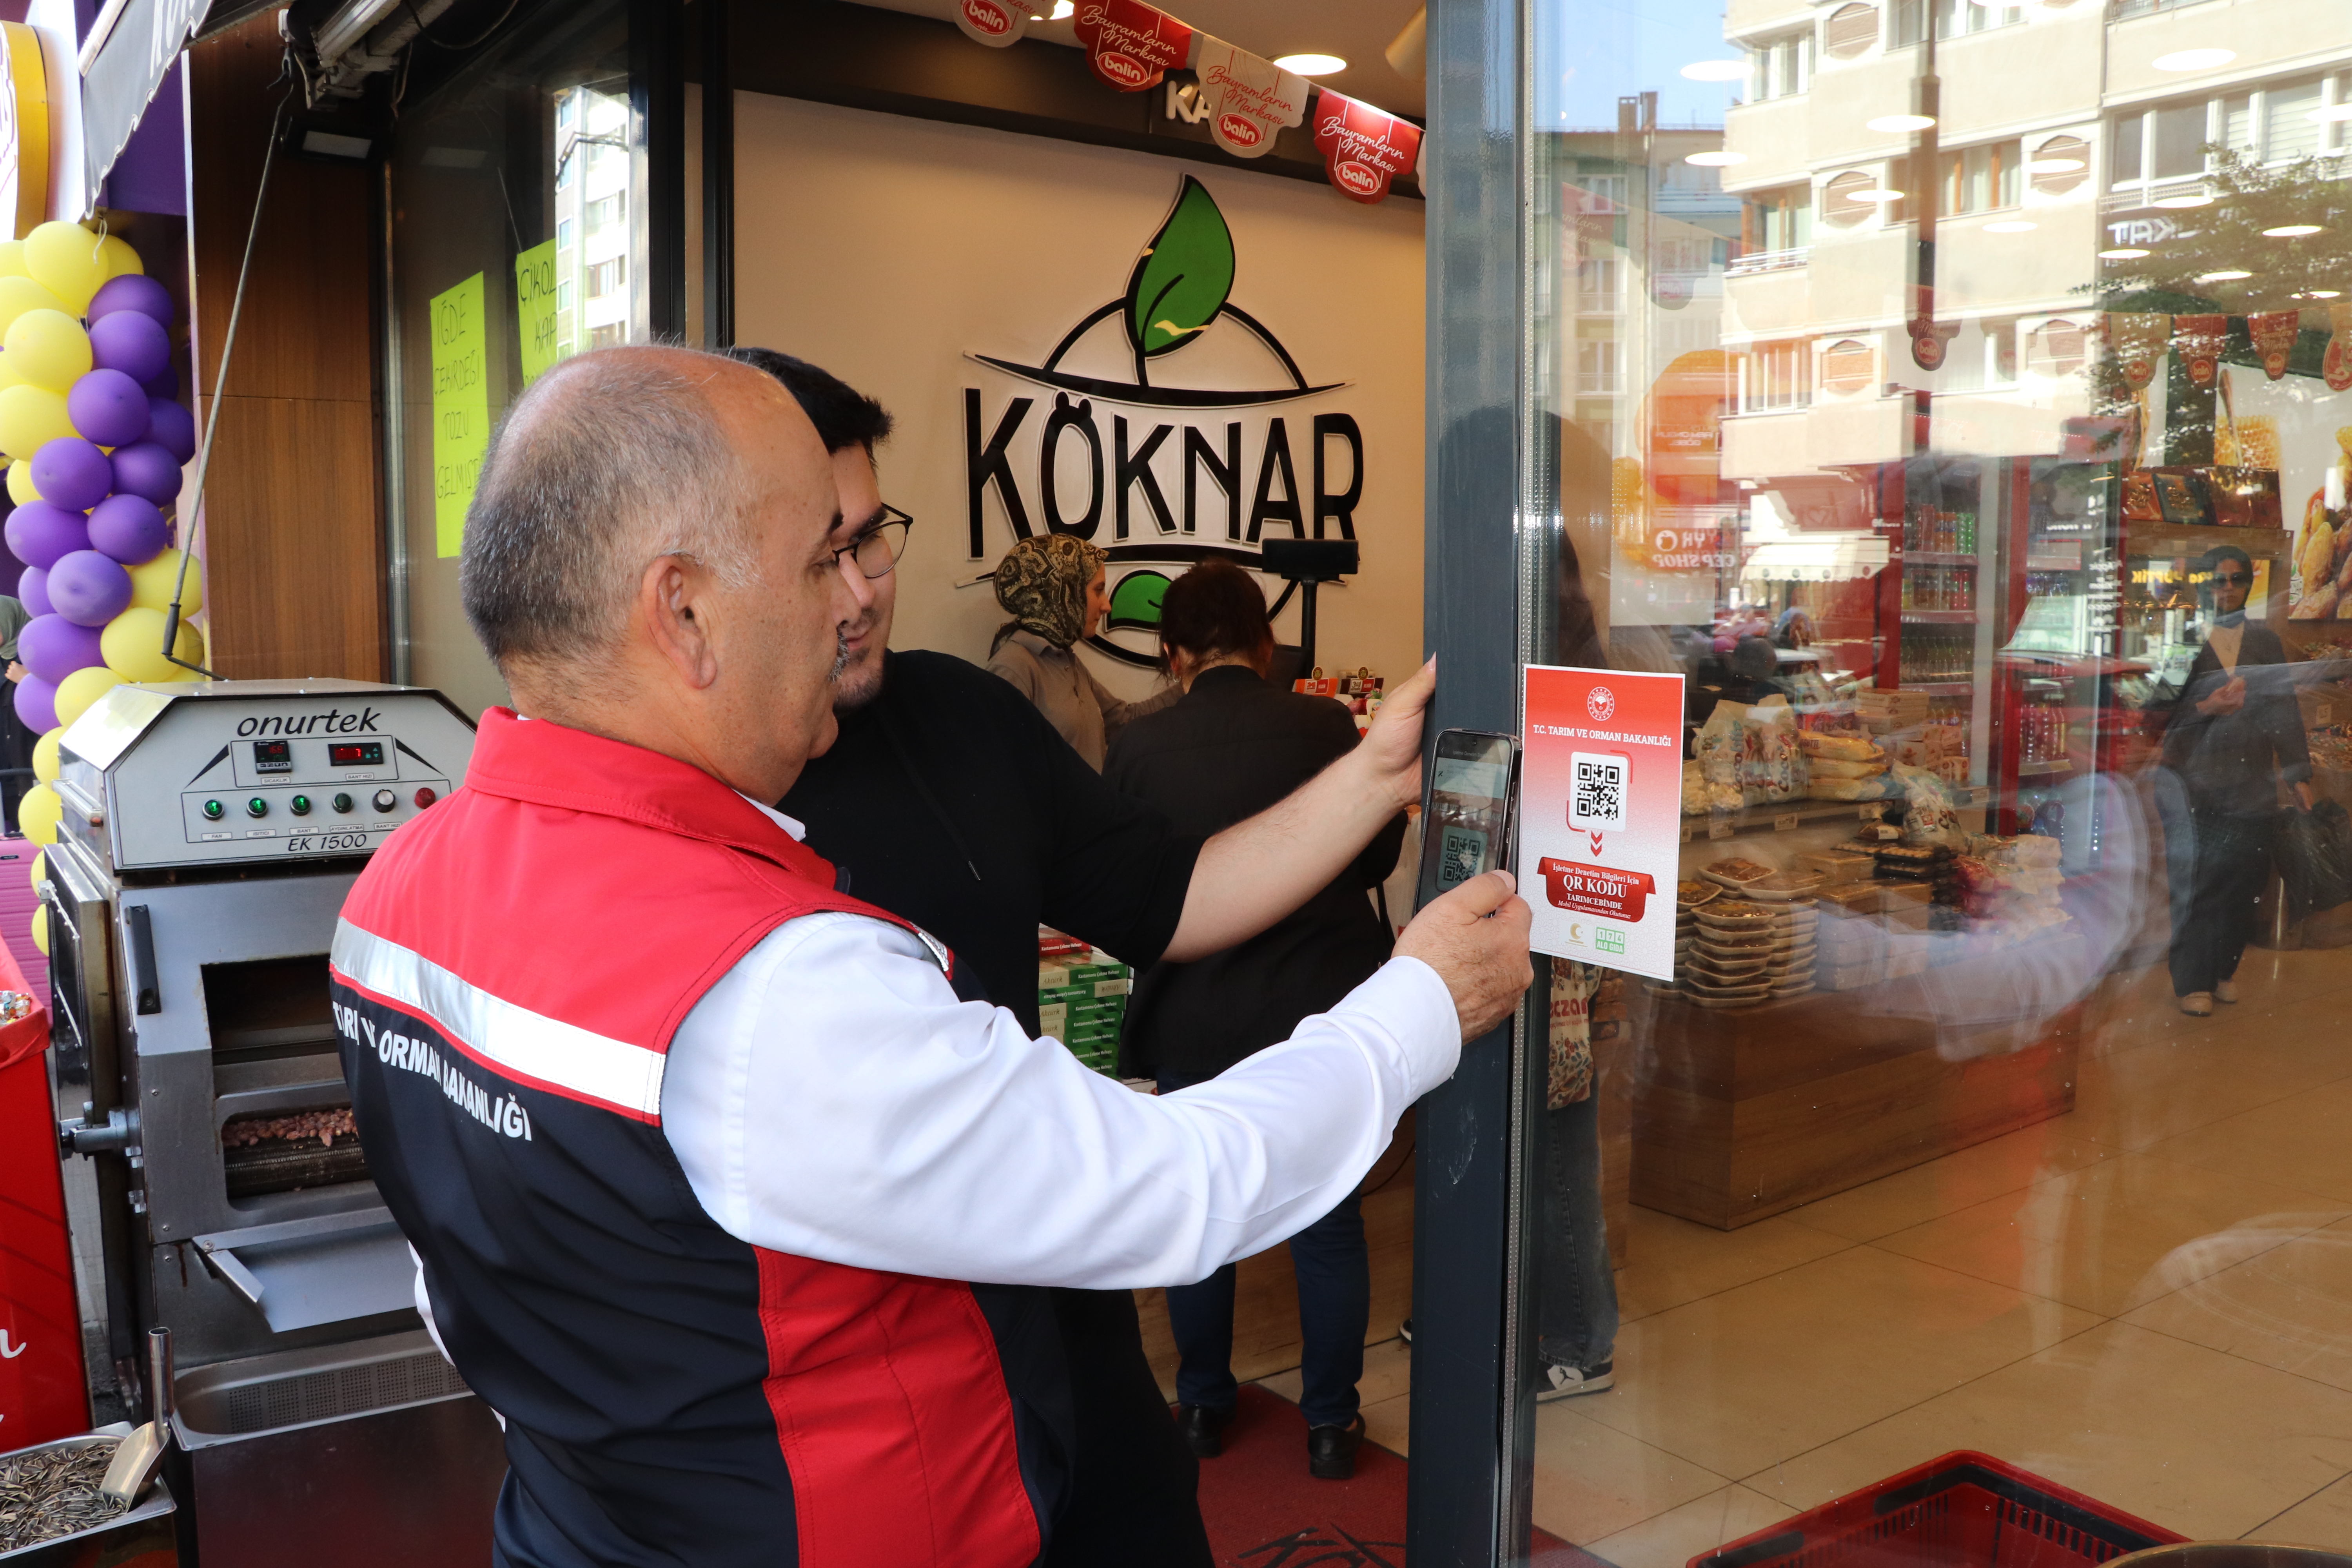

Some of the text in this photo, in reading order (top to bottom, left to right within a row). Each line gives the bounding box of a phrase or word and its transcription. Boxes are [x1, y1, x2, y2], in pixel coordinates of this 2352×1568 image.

[969, 0, 1004, 30] balin
[1081, 5, 1176, 54] Bayramların
[1103, 29, 1169, 66] Markası
[1104, 55, 1141, 81] balin
[1166, 80, 1212, 124] KA
[1207, 65, 1292, 111] Bayramların
[1225, 89, 1285, 125] Markası
[1223, 117, 1256, 142] balin
[1321, 116, 1405, 159] Bayramların
[1341, 138, 1397, 172] Markası
[1342, 165, 1374, 189] balin
[520, 258, 557, 308] ÇİKOL
[535, 312, 557, 354] KAP
[443, 408, 469, 441] TOZU
[963, 387, 1364, 561] KÖKNAR
[237, 707, 381, 737] onurtek
[1533, 724, 1671, 746] T.C. TARIM VE ORMAN BAKANLIĞI
[288, 833, 367, 851] EK 1500
[1552, 862, 1640, 885] İşletme Denetim Bilgileri İçin
[1563, 874, 1628, 898] QR KODU
[1566, 893, 1623, 910] TARIMCEBİMDE
[1572, 902, 1609, 915] Uygulamasından
[1609, 910, 1631, 919] Okutunuz
[1597, 940, 1608, 950] ALO
[1609, 942, 1623, 953] GIDA
[443, 1060, 532, 1141] BAKANLIĞI
